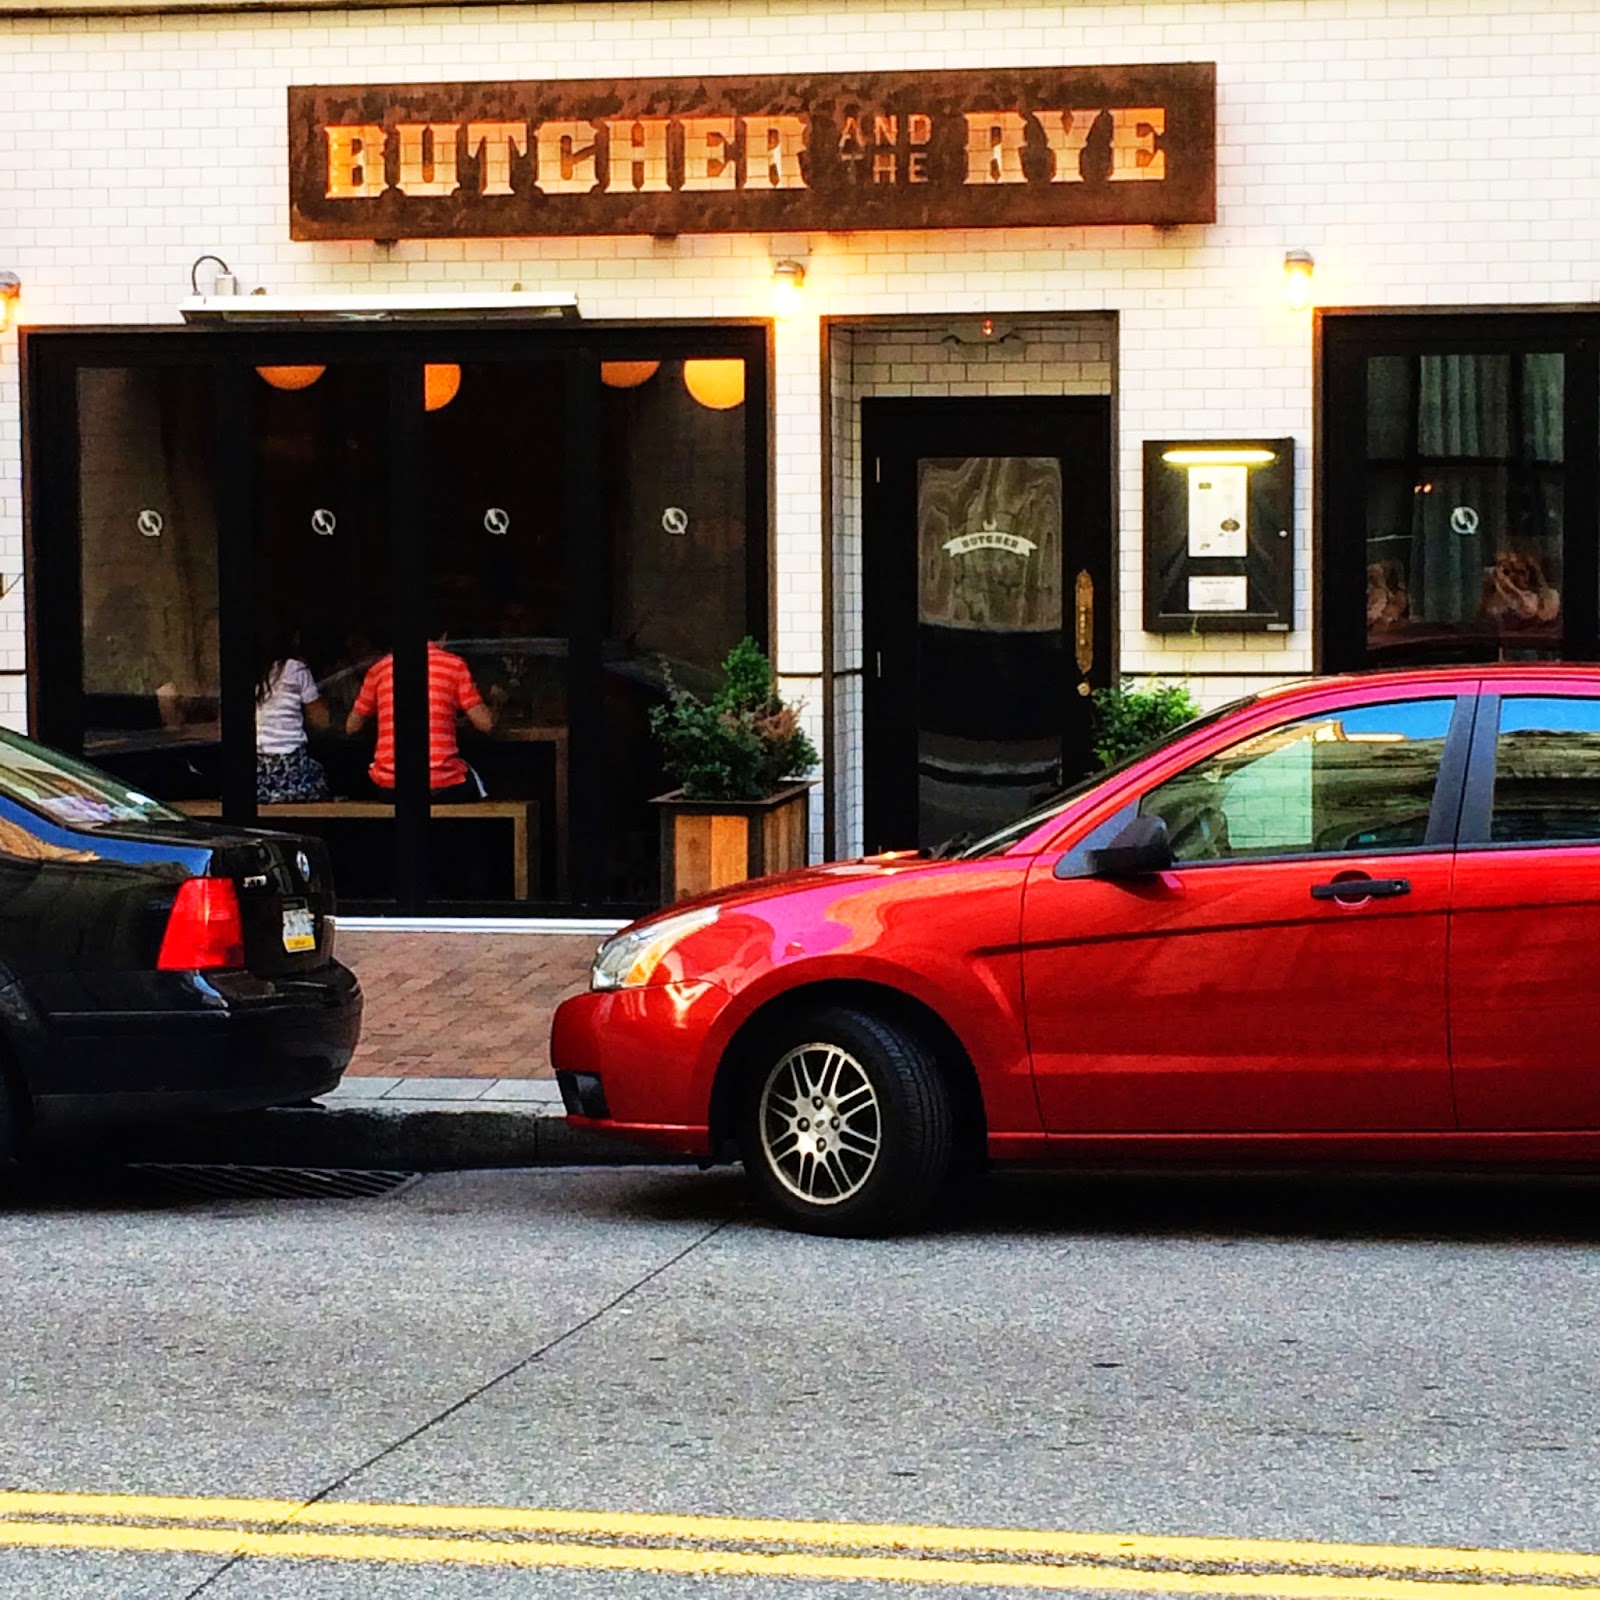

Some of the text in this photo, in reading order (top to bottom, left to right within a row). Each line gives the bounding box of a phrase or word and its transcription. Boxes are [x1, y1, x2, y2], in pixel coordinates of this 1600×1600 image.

[324, 114, 809, 199] BUTCHER
[838, 112, 933, 148] AND
[963, 106, 1167, 185] RYE
[838, 152, 929, 185] THE
